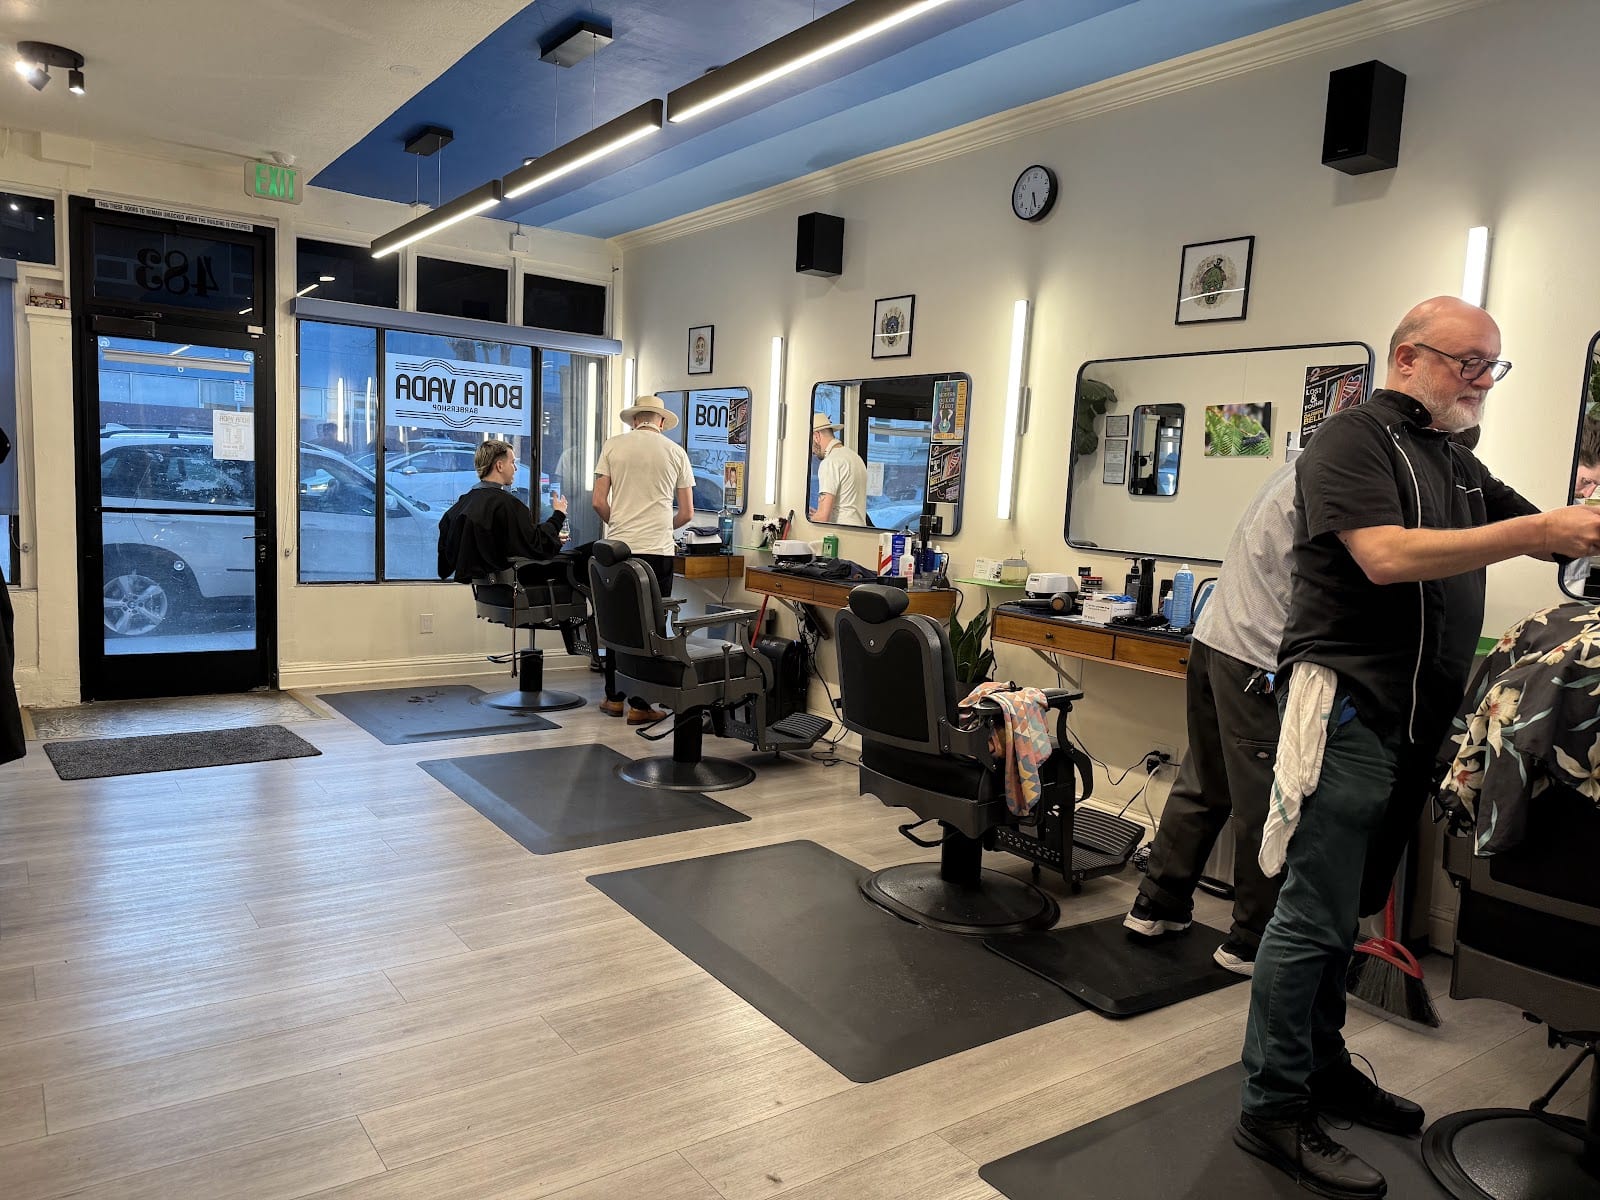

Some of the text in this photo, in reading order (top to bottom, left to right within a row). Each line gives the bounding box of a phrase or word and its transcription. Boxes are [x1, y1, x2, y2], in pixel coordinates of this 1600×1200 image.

[255, 163, 297, 201] EXIT
[1305, 387, 1322, 396] LOST
[1304, 400, 1323, 411] FOUND
